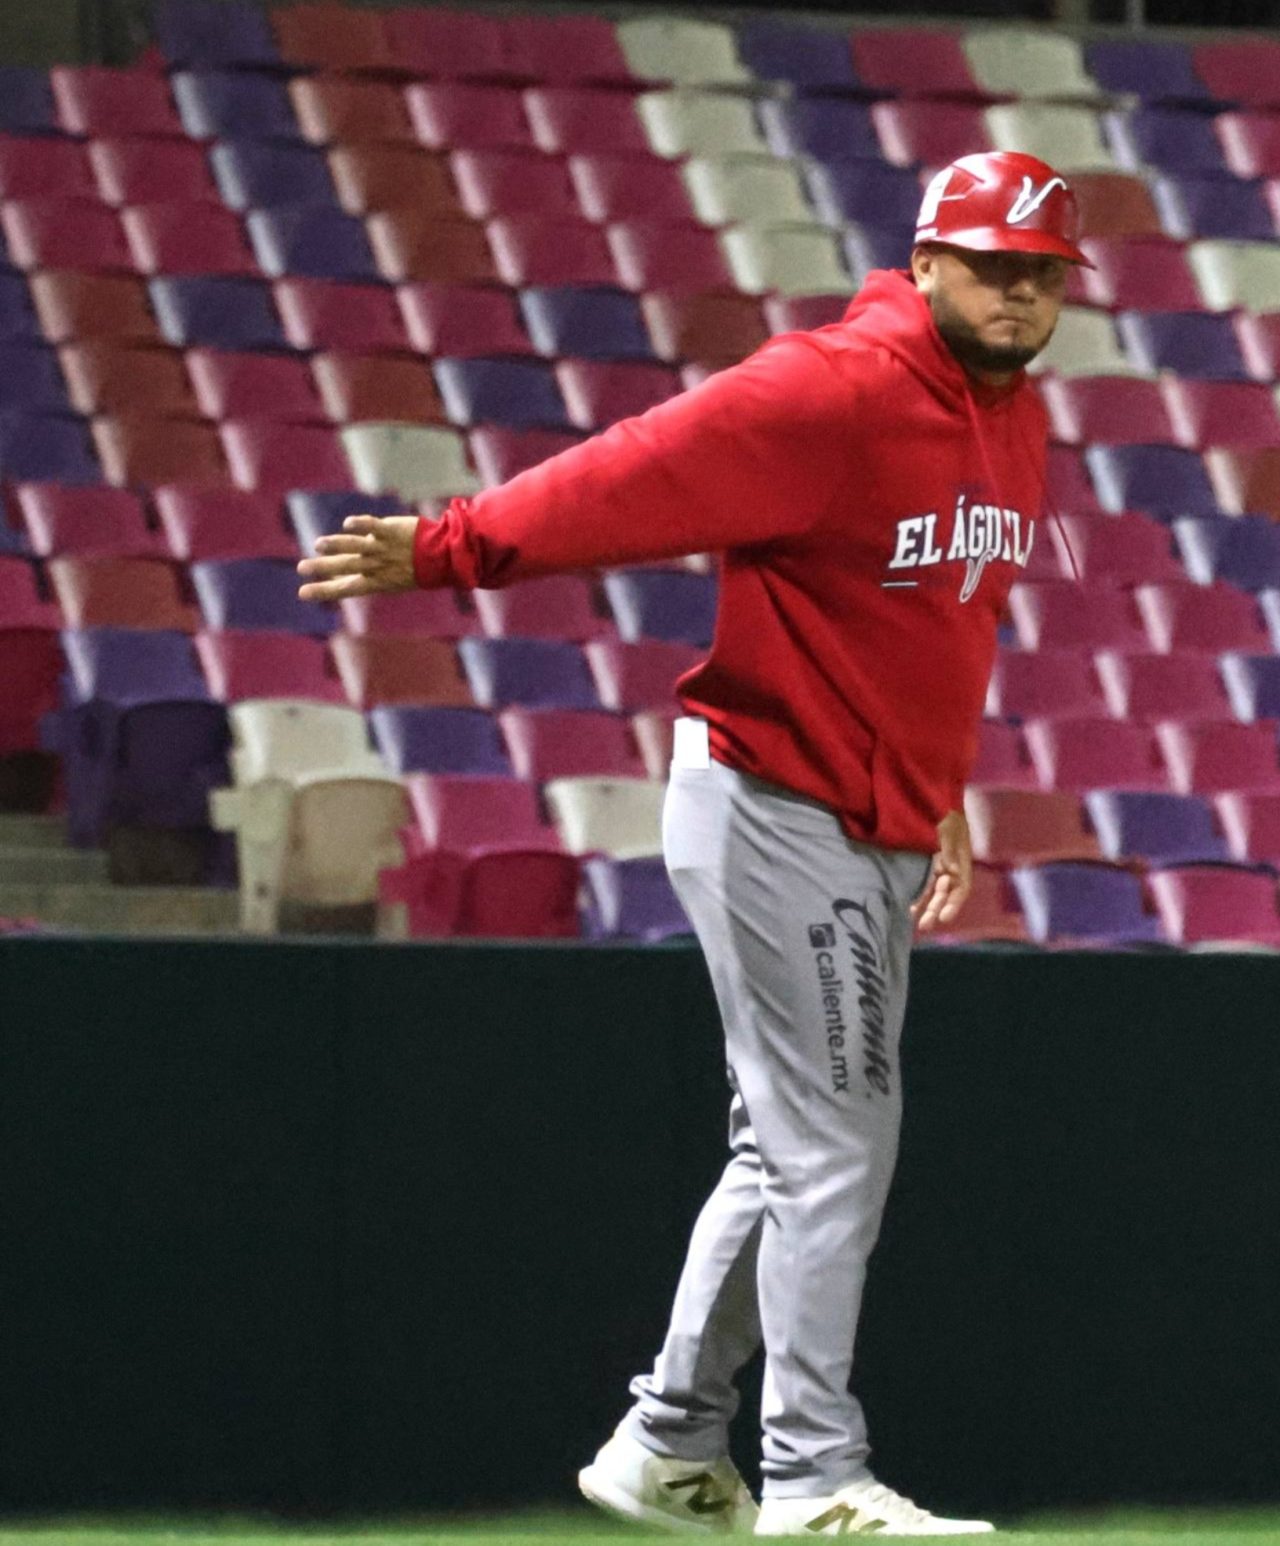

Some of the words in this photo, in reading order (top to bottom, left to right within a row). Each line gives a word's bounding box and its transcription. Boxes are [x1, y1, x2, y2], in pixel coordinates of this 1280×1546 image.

[888, 513, 942, 568] EL
[946, 495, 1035, 568] ÁGUIL
[815, 951, 850, 1093] caliente.mx
